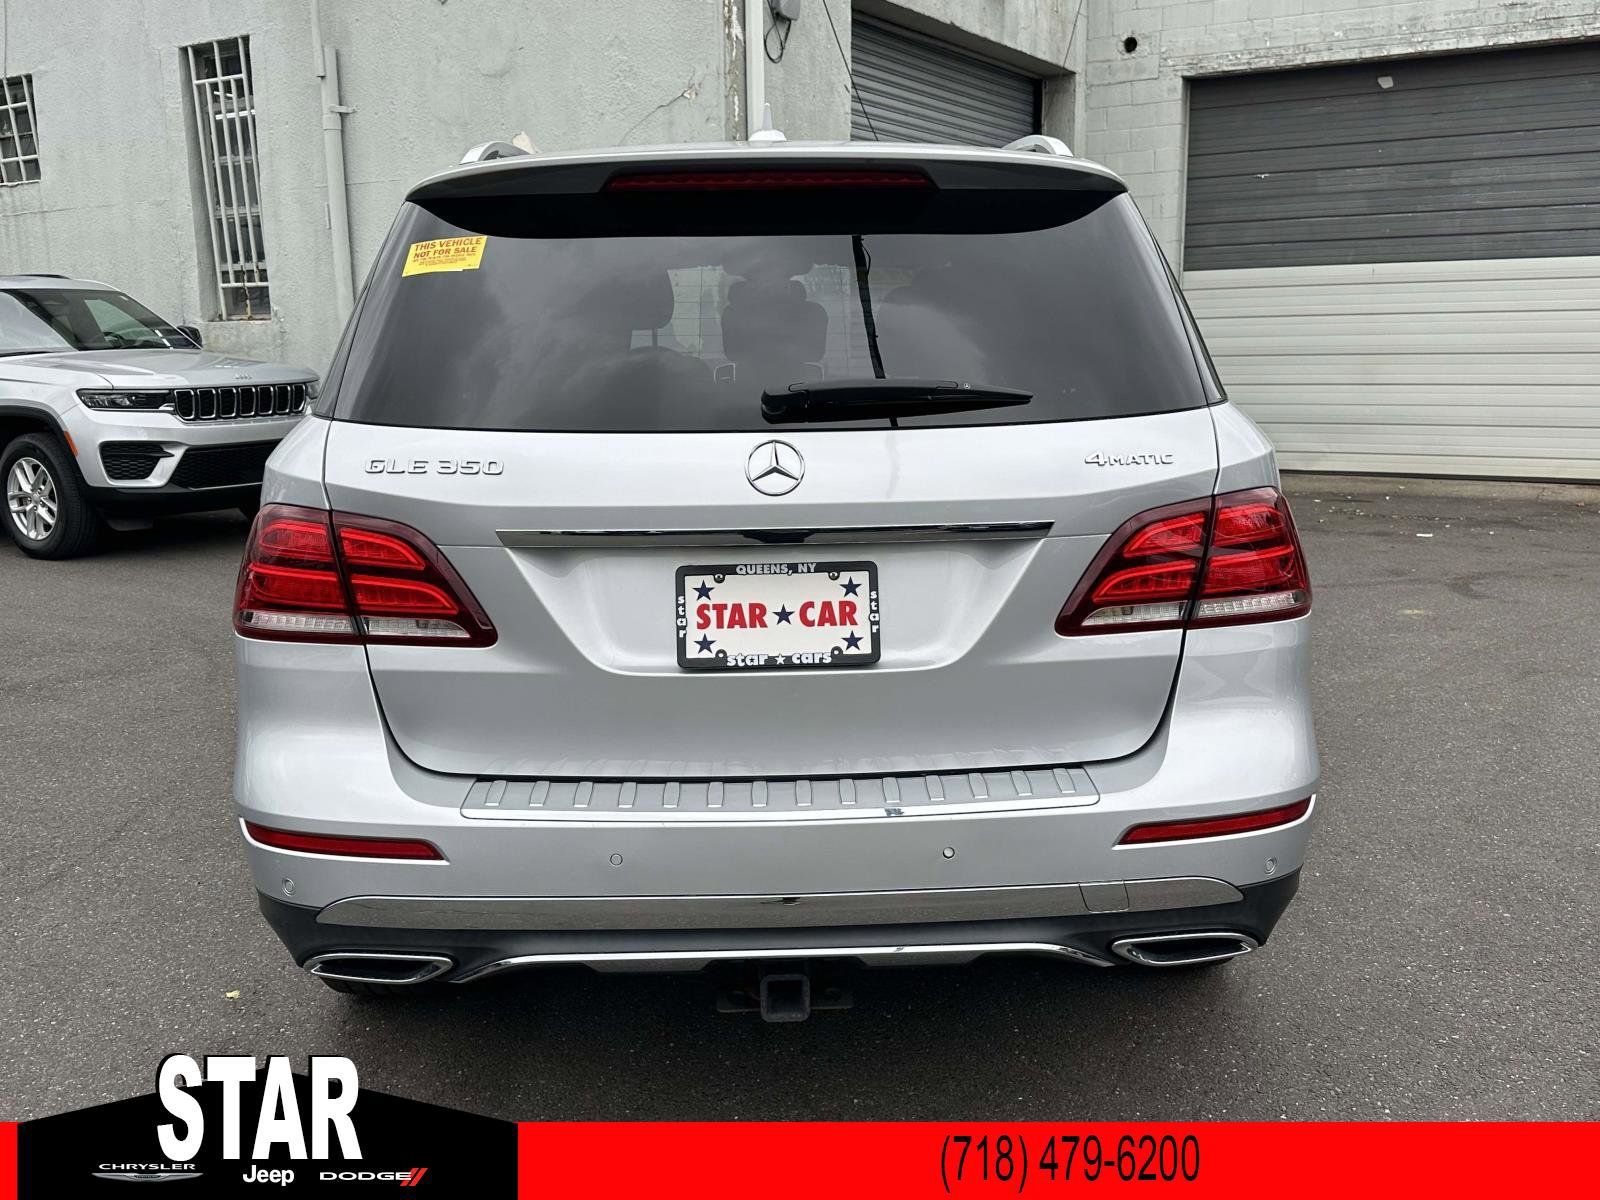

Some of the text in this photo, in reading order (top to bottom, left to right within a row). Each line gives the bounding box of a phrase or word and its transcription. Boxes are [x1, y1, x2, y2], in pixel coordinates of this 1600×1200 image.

[415, 238, 483, 251] THIS VEHICLE
[413, 250, 431, 259] NOT
[433, 248, 451, 256] FOR
[365, 458, 504, 475] GLE 350
[1084, 451, 1175, 467] 4MATIC
[735, 562, 817, 576] QUEENS, NY
[676, 595, 688, 638] star
[696, 600, 859, 630] STAR CAR
[869, 590, 880, 633] star
[726, 651, 833, 667] star cars
